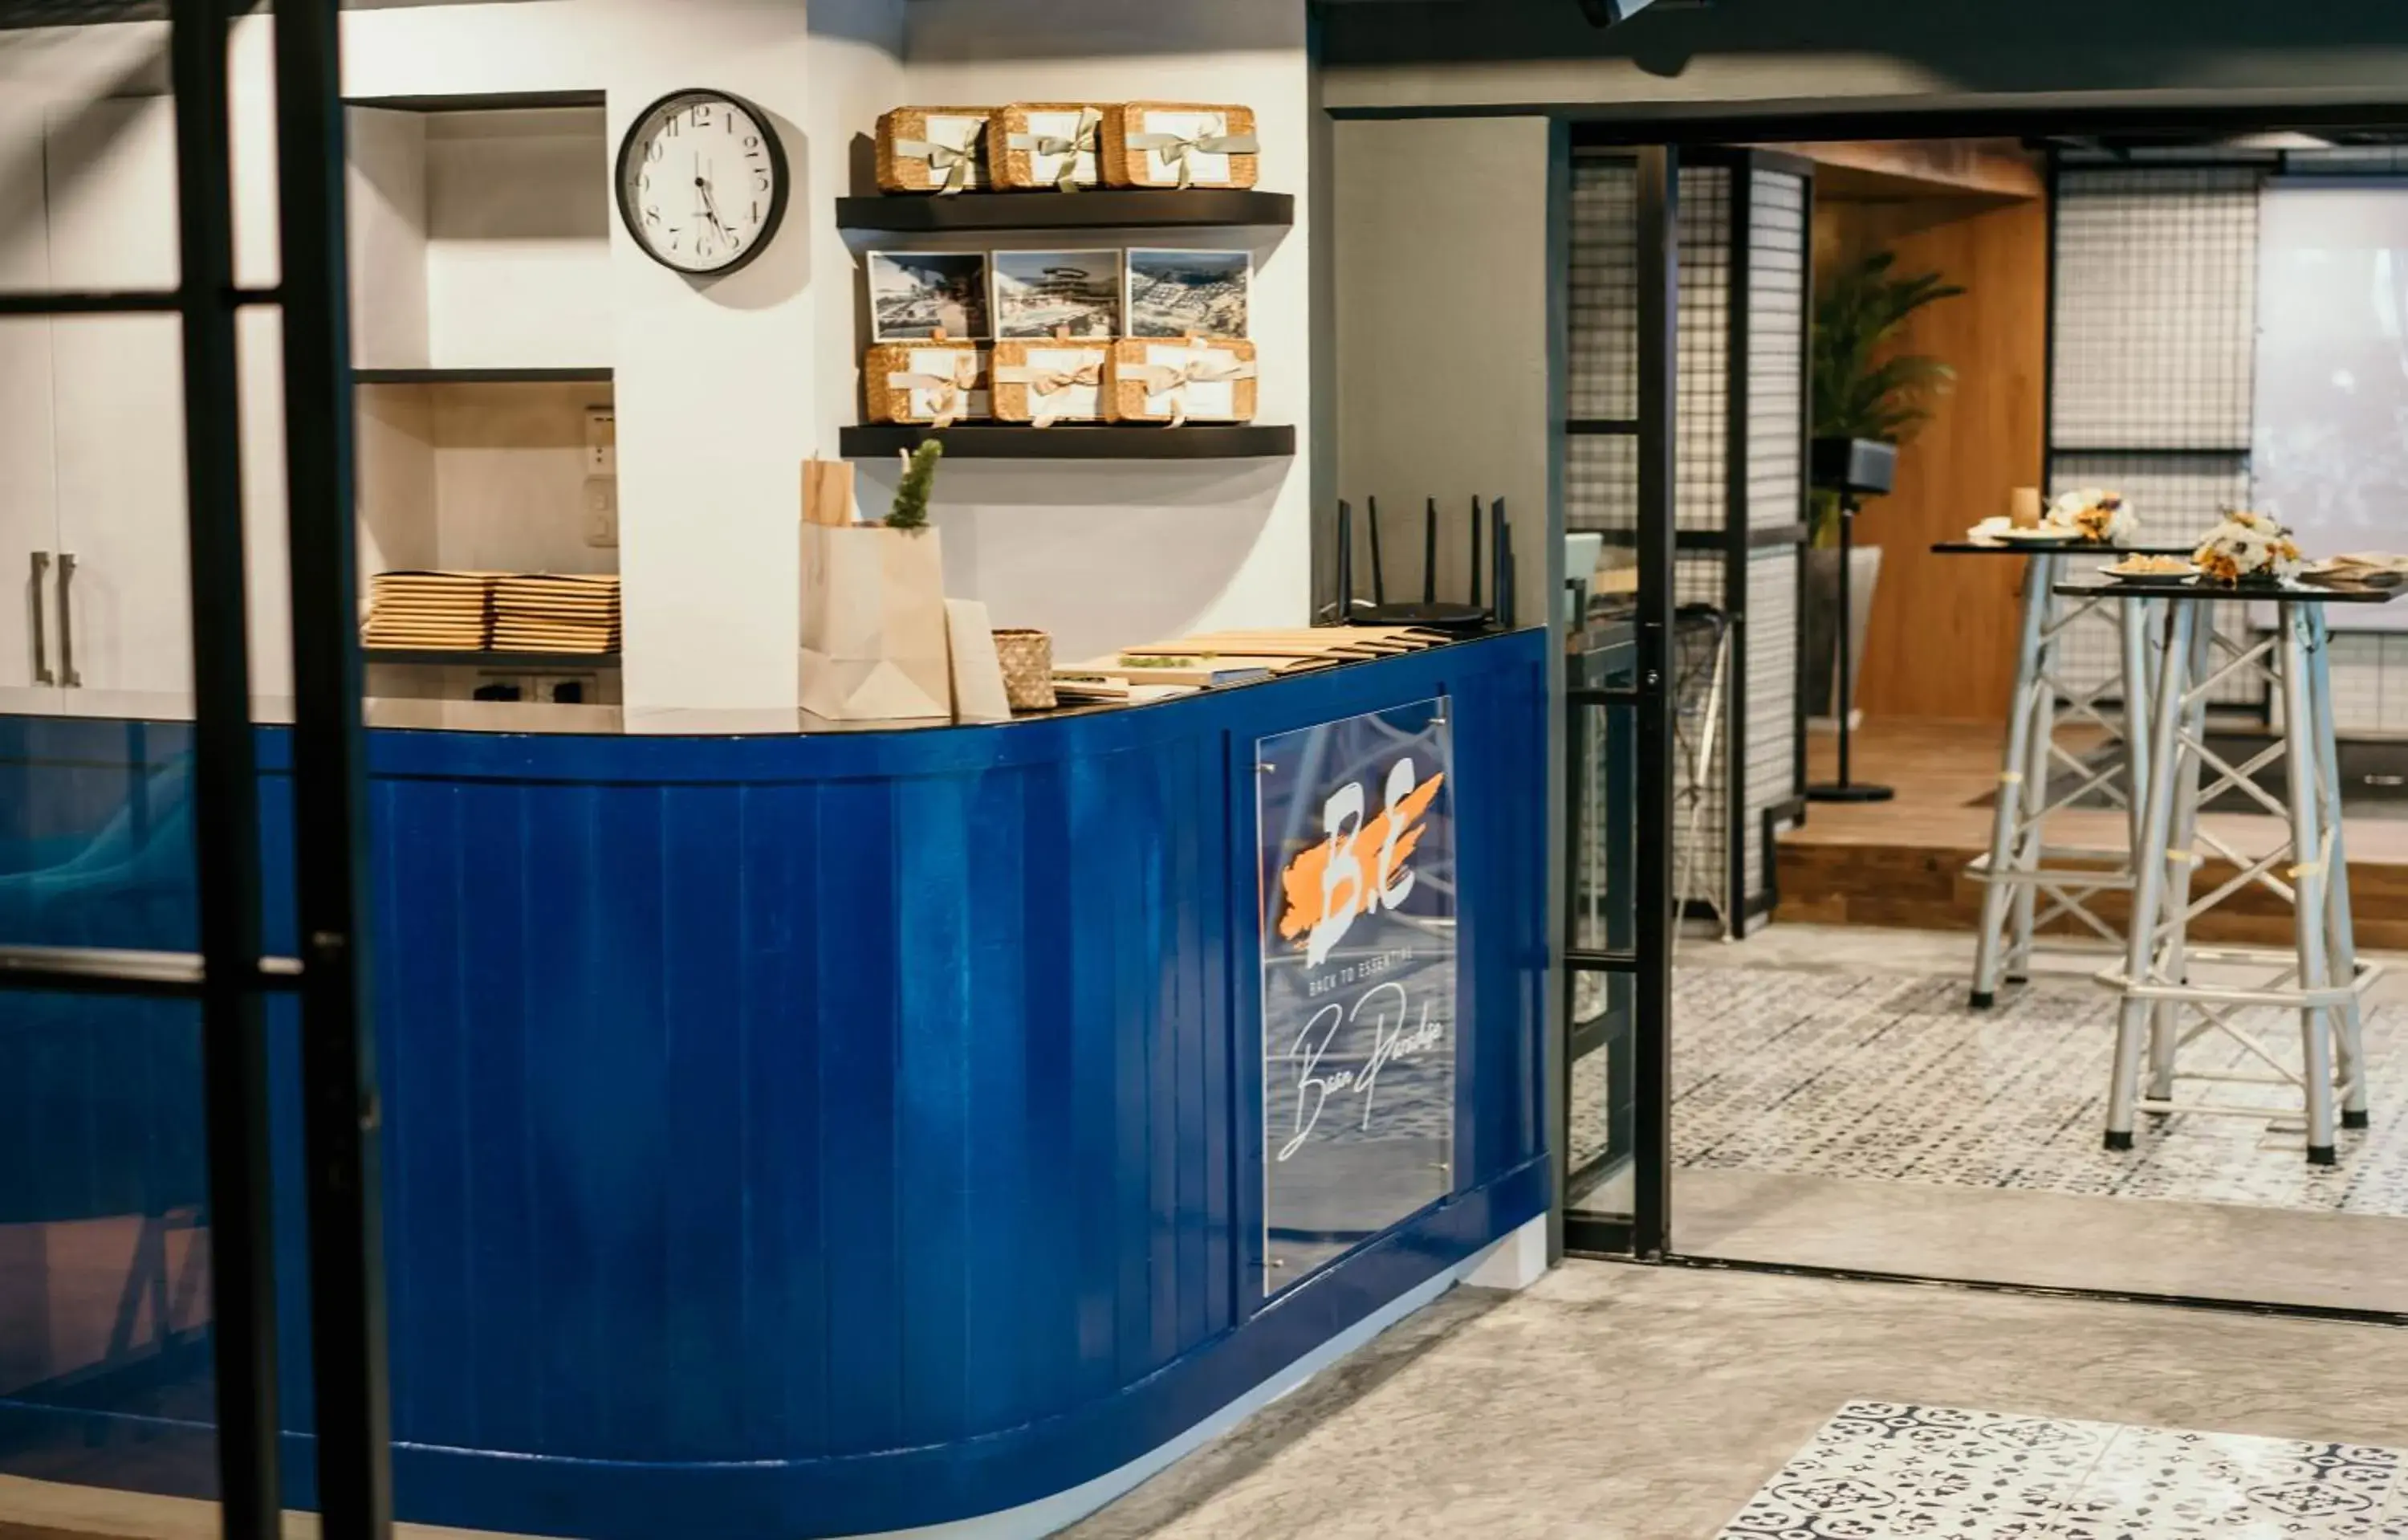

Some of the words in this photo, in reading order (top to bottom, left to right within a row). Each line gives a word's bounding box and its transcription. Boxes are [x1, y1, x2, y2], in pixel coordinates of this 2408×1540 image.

[665, 116, 678, 136] 11
[691, 104, 711, 128] 12
[726, 112, 733, 134] 1
[644, 141, 663, 162] 10
[743, 136, 759, 157] 2
[635, 173, 650, 193] 9
[753, 168, 769, 192] 3
[645, 205, 661, 226] 8
[744, 201, 761, 224] 4
[669, 227, 681, 250] 7
[696, 235, 712, 258] 6
[725, 226, 740, 249] 5
[1308, 973, 1337, 997] BACK
[1340, 967, 1355, 984] TO
